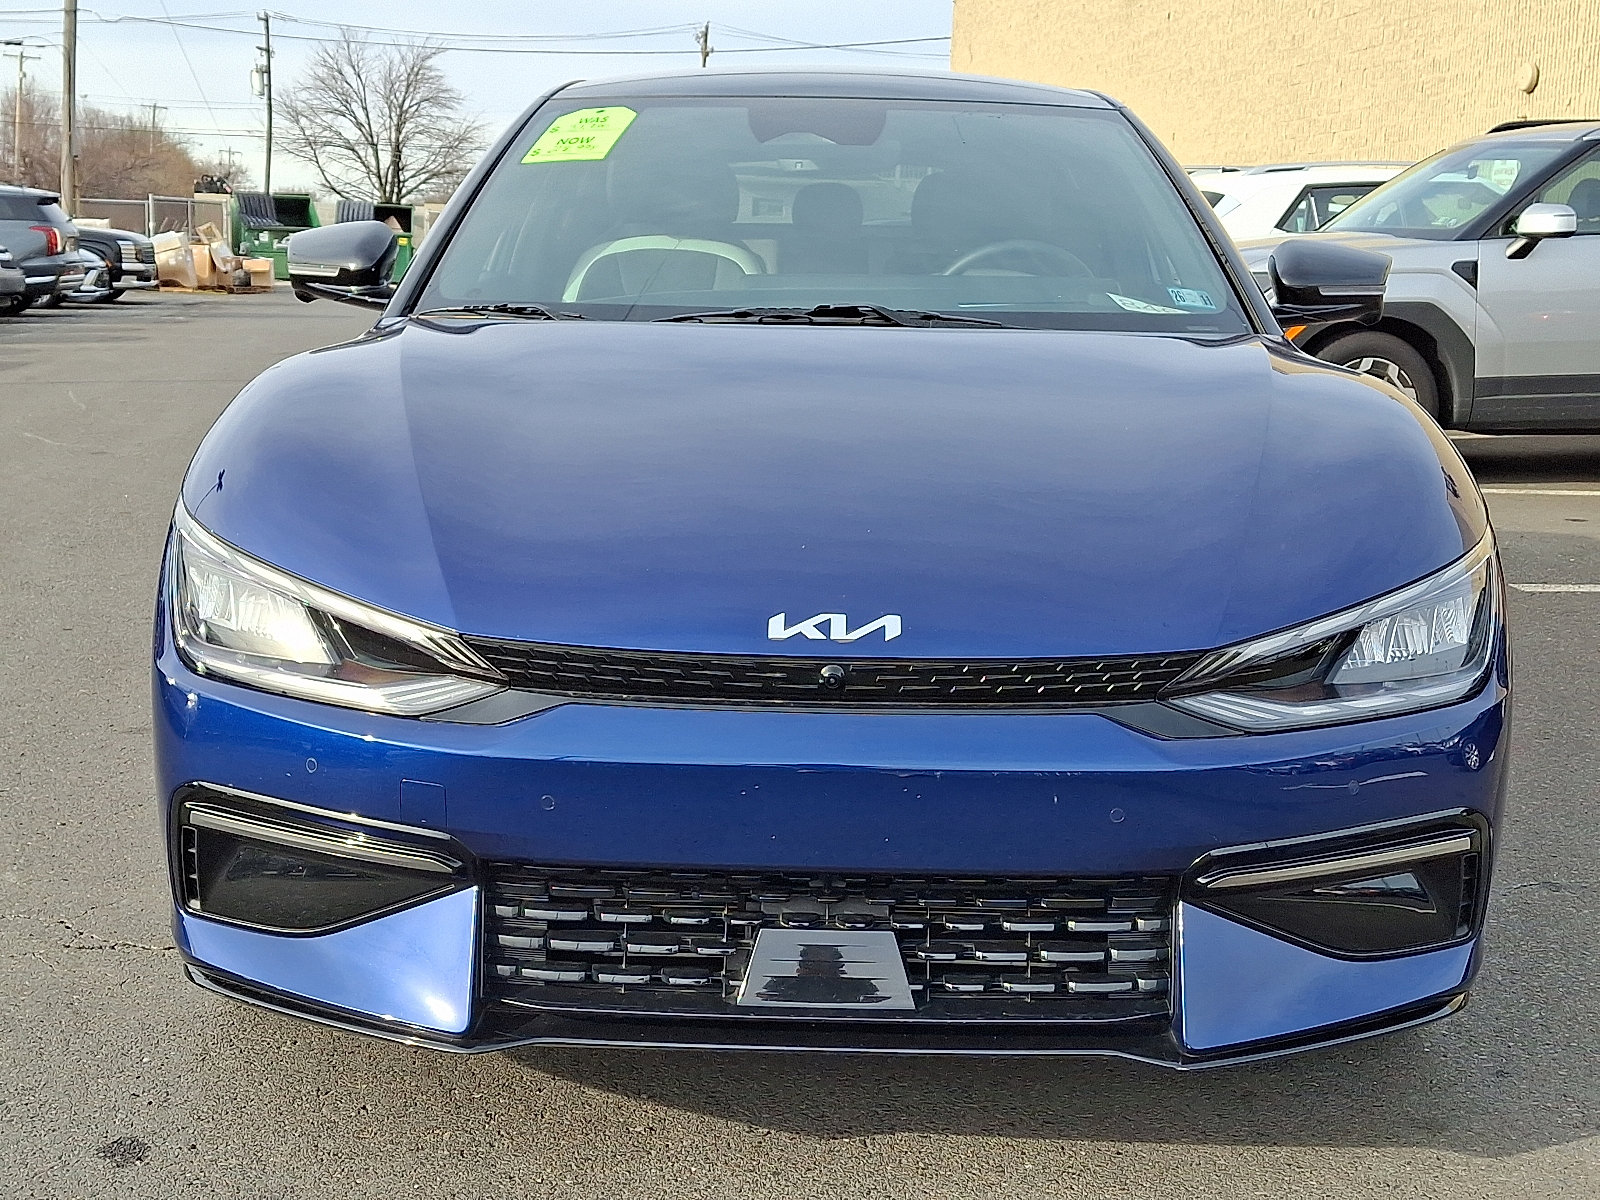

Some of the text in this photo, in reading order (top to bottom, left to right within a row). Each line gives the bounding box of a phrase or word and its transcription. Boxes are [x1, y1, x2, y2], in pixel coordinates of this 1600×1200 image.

[579, 116, 609, 124] WAS
[557, 136, 596, 145] NOW
[1171, 290, 1186, 302] 26
[768, 612, 903, 642] KIA
